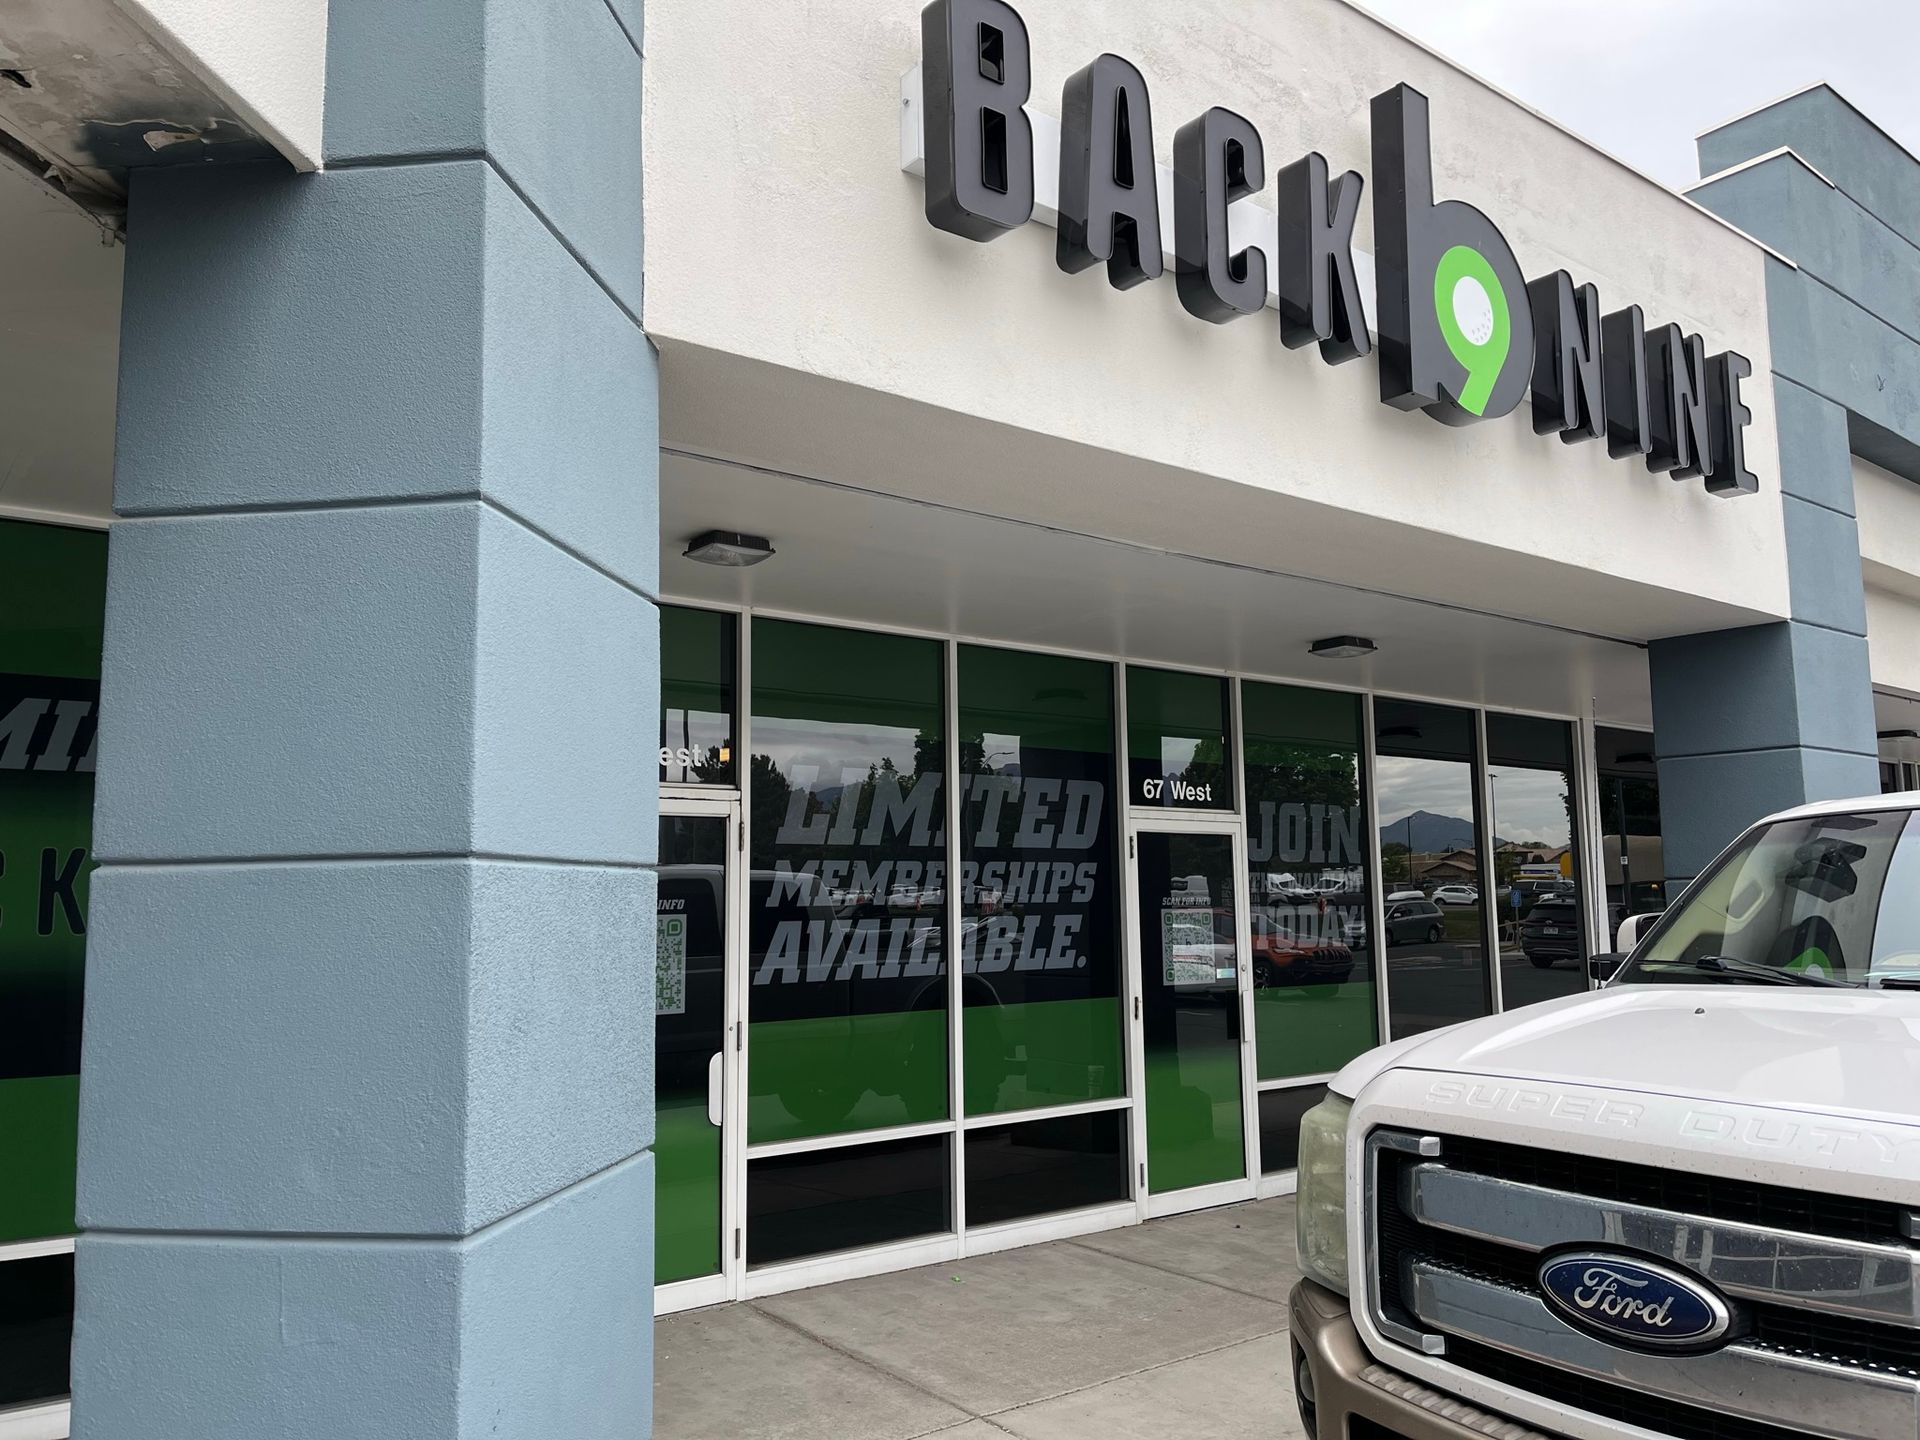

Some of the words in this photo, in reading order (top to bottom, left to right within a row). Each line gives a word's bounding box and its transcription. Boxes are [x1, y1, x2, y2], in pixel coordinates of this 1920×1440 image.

[921, 0, 1371, 366] BACK
[1528, 269, 1759, 498] NINE
[1143, 779, 1164, 799] 67
[1170, 780, 1212, 802] West
[1248, 801, 1361, 863] JOIN
[657, 899, 685, 910] INFO
[766, 860, 1098, 907] MEMBERSHIPS
[753, 914, 1087, 985] AVAILABLE.
[1251, 904, 1366, 949] TODAY!
[1425, 1080, 1646, 1129] SUPER
[1677, 1109, 1920, 1163] DUTY
[1574, 1268, 1675, 1327] Ford
